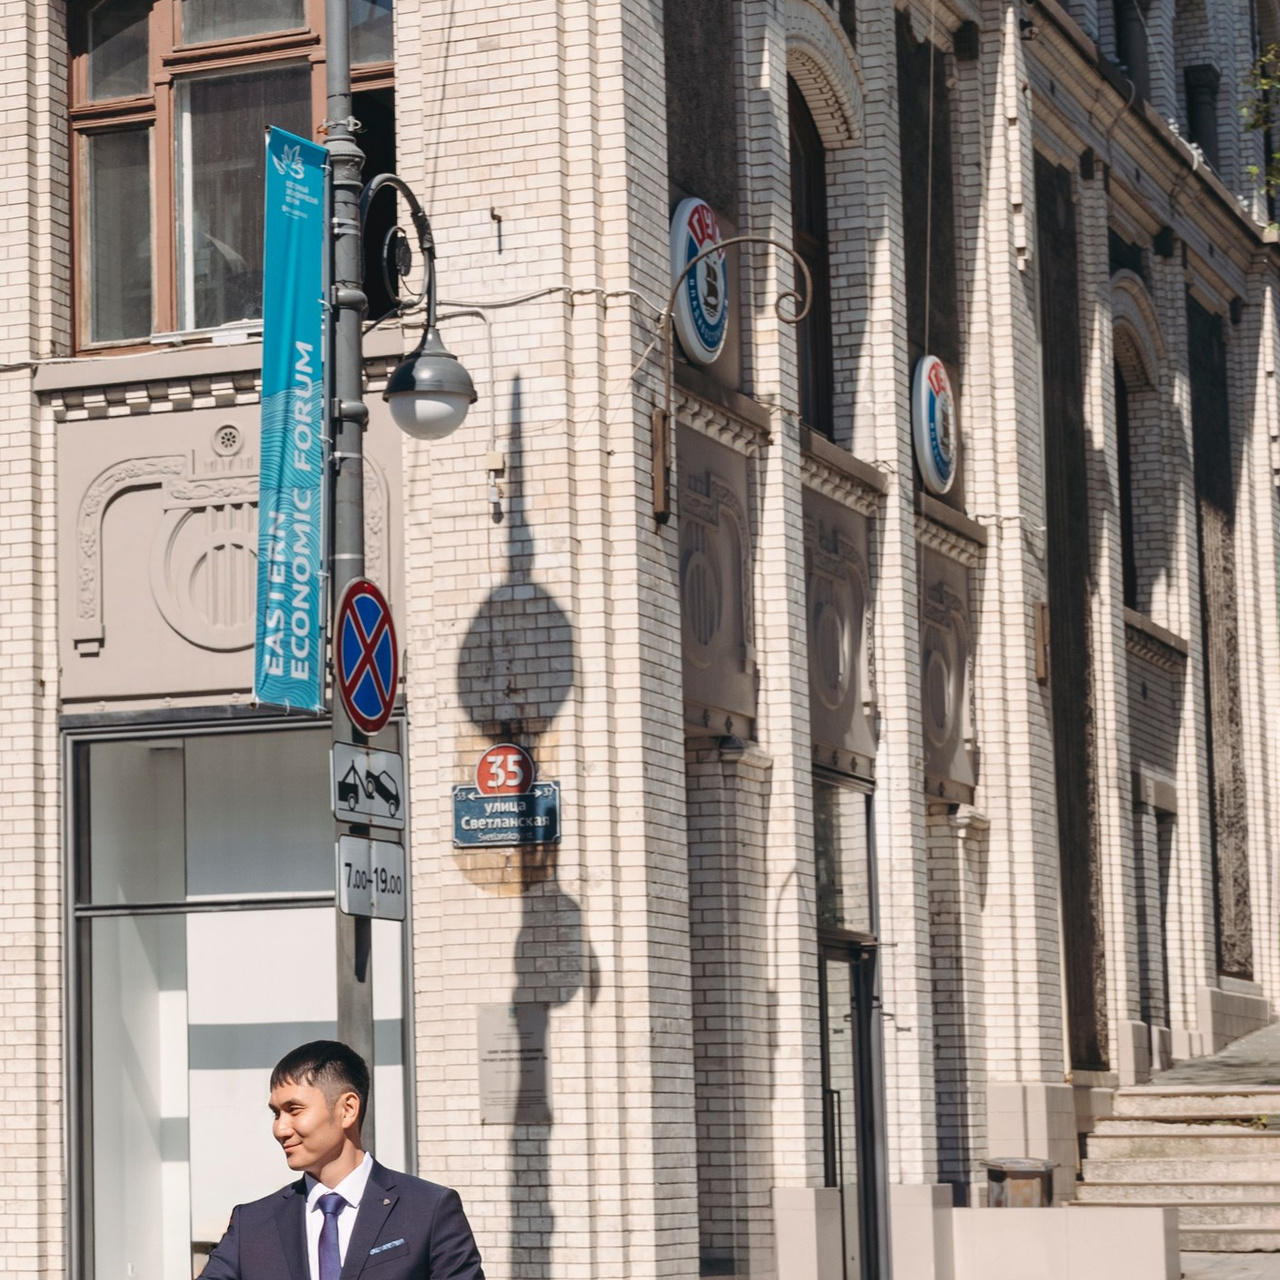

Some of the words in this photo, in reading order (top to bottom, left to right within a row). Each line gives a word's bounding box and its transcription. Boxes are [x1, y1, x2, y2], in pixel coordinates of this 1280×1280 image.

[294, 340, 314, 472] FORUM
[264, 510, 287, 677] EASTERN
[290, 487, 312, 681] ECONOMIC
[484, 801, 526, 816] улица
[486, 754, 524, 787] 35
[460, 815, 550, 830] Светланская
